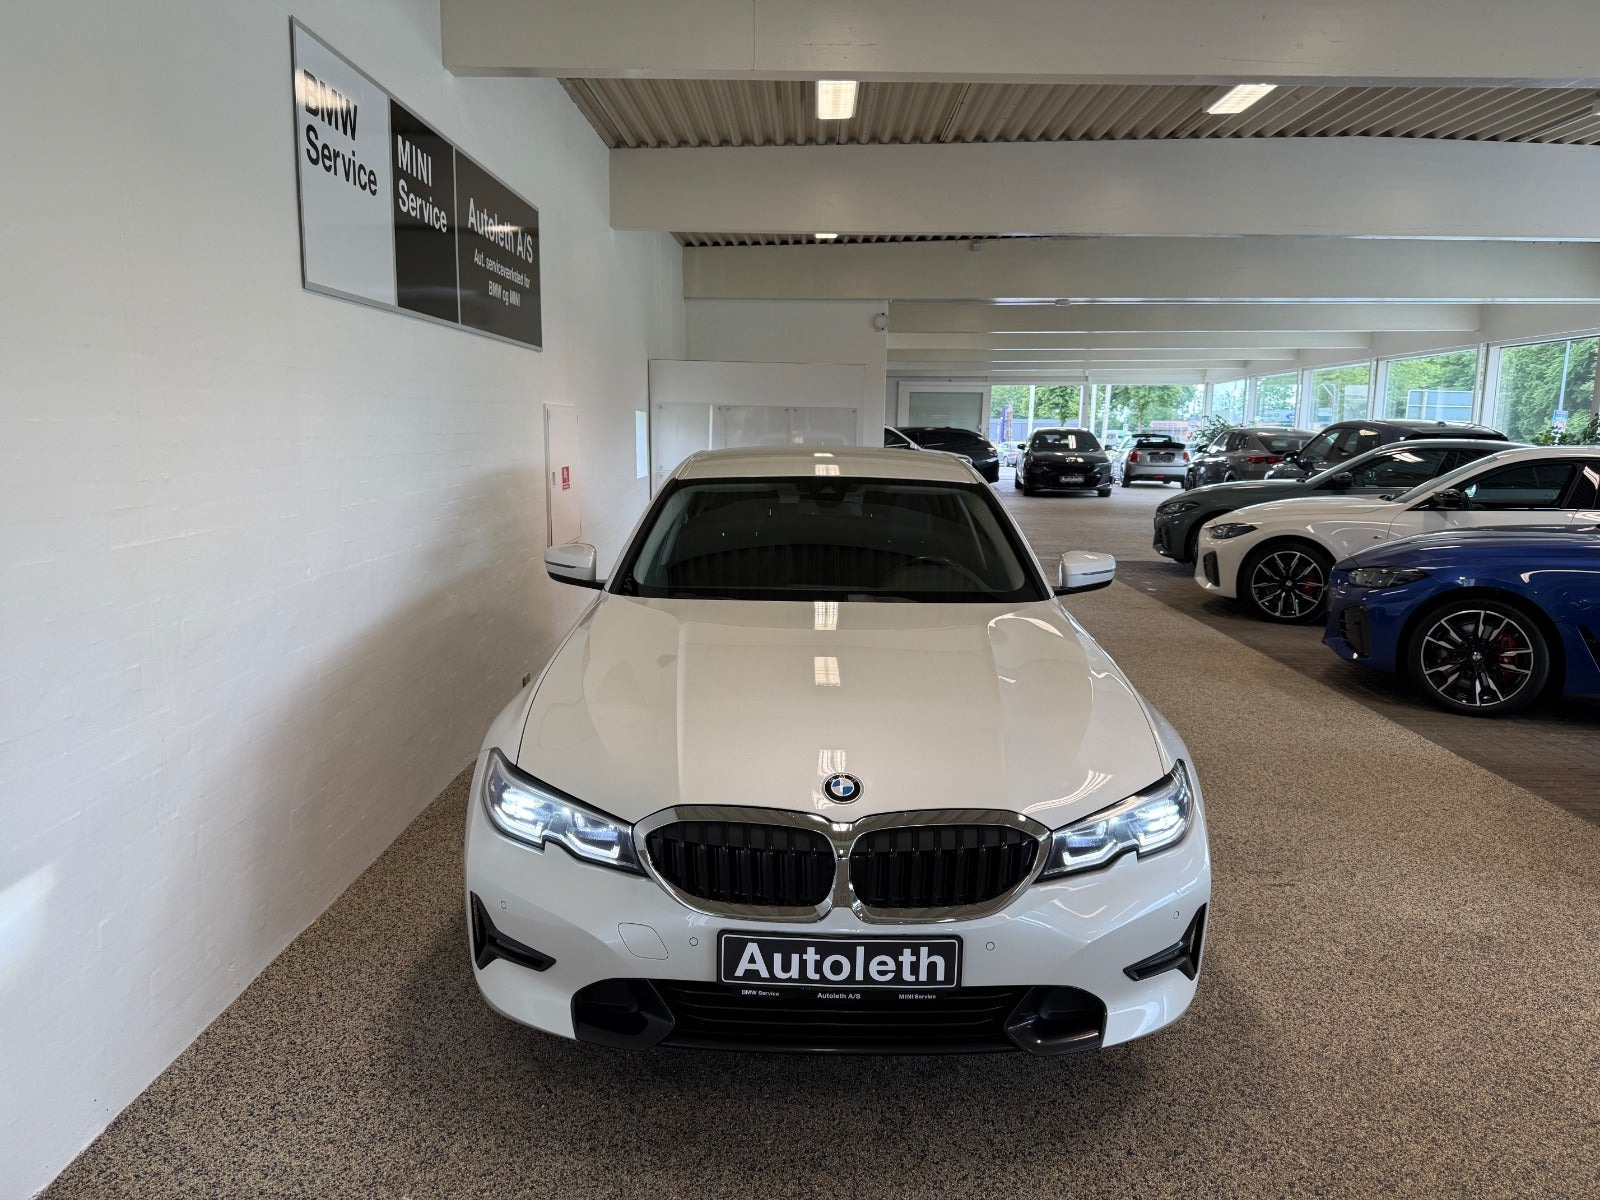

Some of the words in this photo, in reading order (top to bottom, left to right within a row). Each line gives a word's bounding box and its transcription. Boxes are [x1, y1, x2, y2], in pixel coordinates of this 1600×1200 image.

[303, 69, 358, 141] BMW
[305, 123, 378, 197] Service
[397, 134, 433, 188] MINI
[398, 178, 448, 233] Service
[468, 198, 515, 253] Autoleth
[517, 229, 533, 263] A/S
[474, 249, 485, 267] Aut.
[734, 942, 945, 982] Autoleth
[847, 992, 861, 1000] A/S
